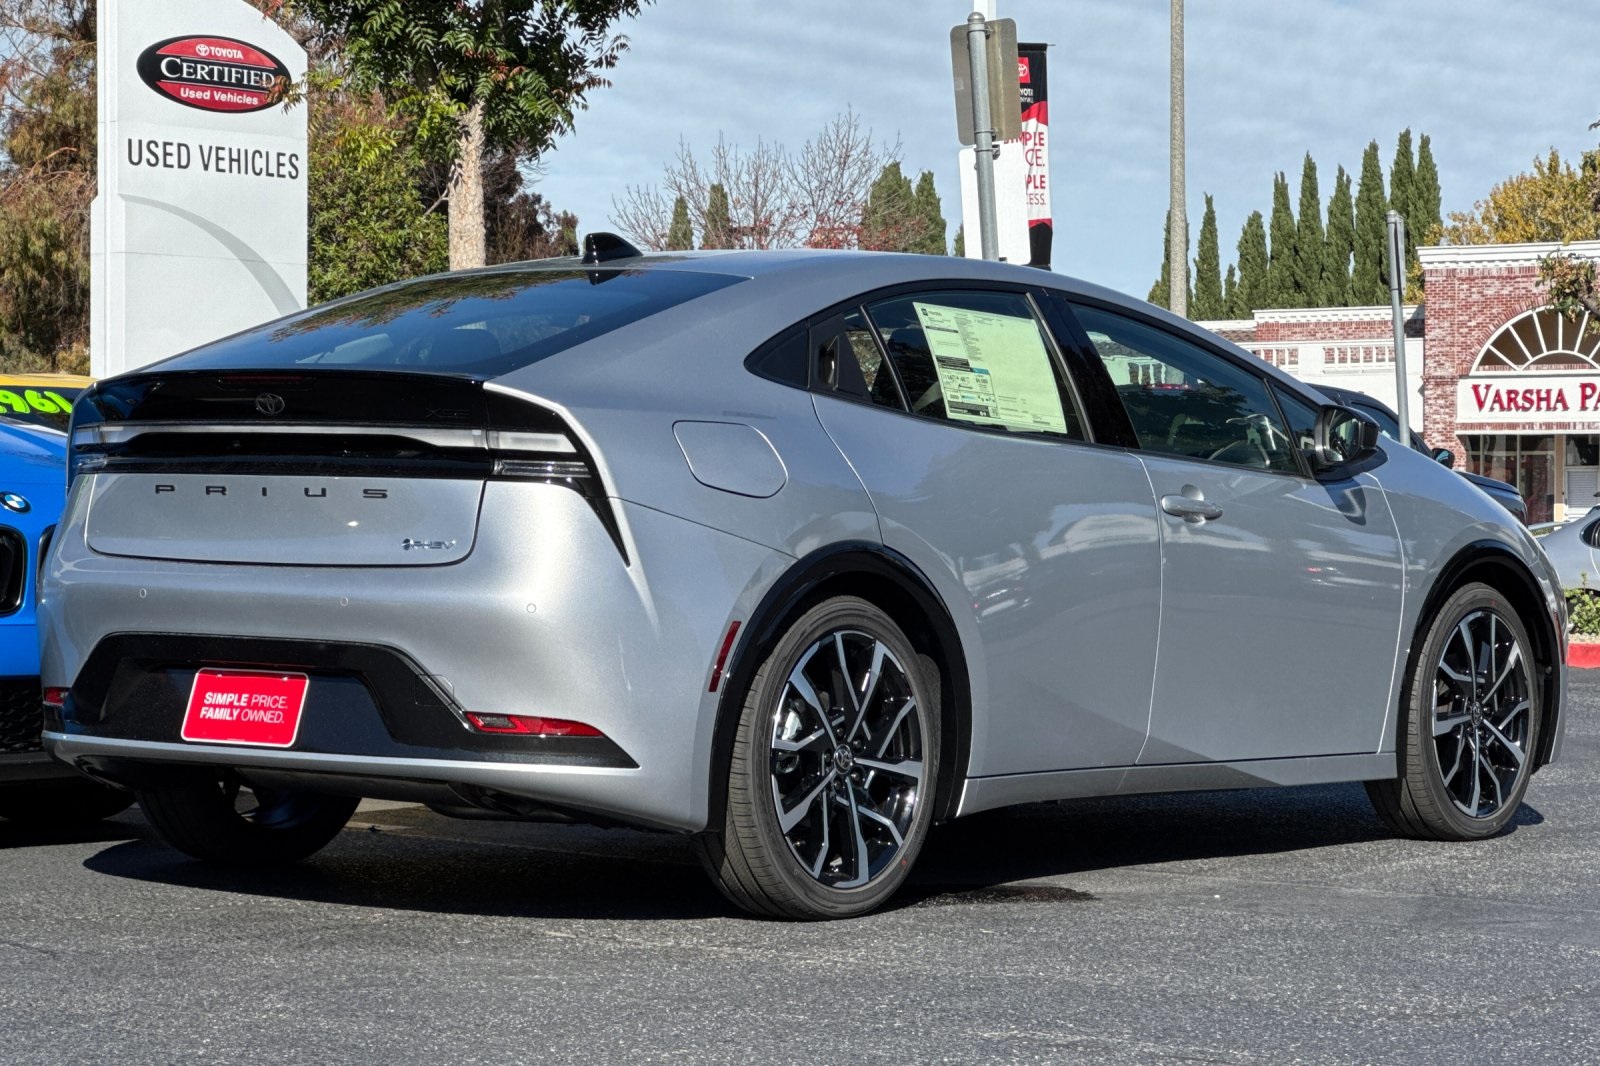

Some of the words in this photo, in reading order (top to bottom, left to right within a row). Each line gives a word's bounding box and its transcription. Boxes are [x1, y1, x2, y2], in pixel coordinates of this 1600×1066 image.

[210, 46, 244, 60] TOYOTA
[160, 57, 275, 88] CERTIFIED
[180, 87, 211, 100] Used
[213, 90, 259, 105] Vehicles
[127, 138, 191, 170] USED
[199, 144, 299, 180] VEHICLES
[1025, 148, 1045, 167] CE.
[1025, 174, 1046, 190] PLE
[0, 389, 73, 414] 961
[1472, 384, 1569, 412] VARSHA
[155, 484, 388, 499] PRIUS
[203, 691, 249, 706] SIMPLE
[250, 694, 288, 709] PRICE.
[199, 706, 240, 721] FAMILY
[240, 708, 285, 724] OWNED.
